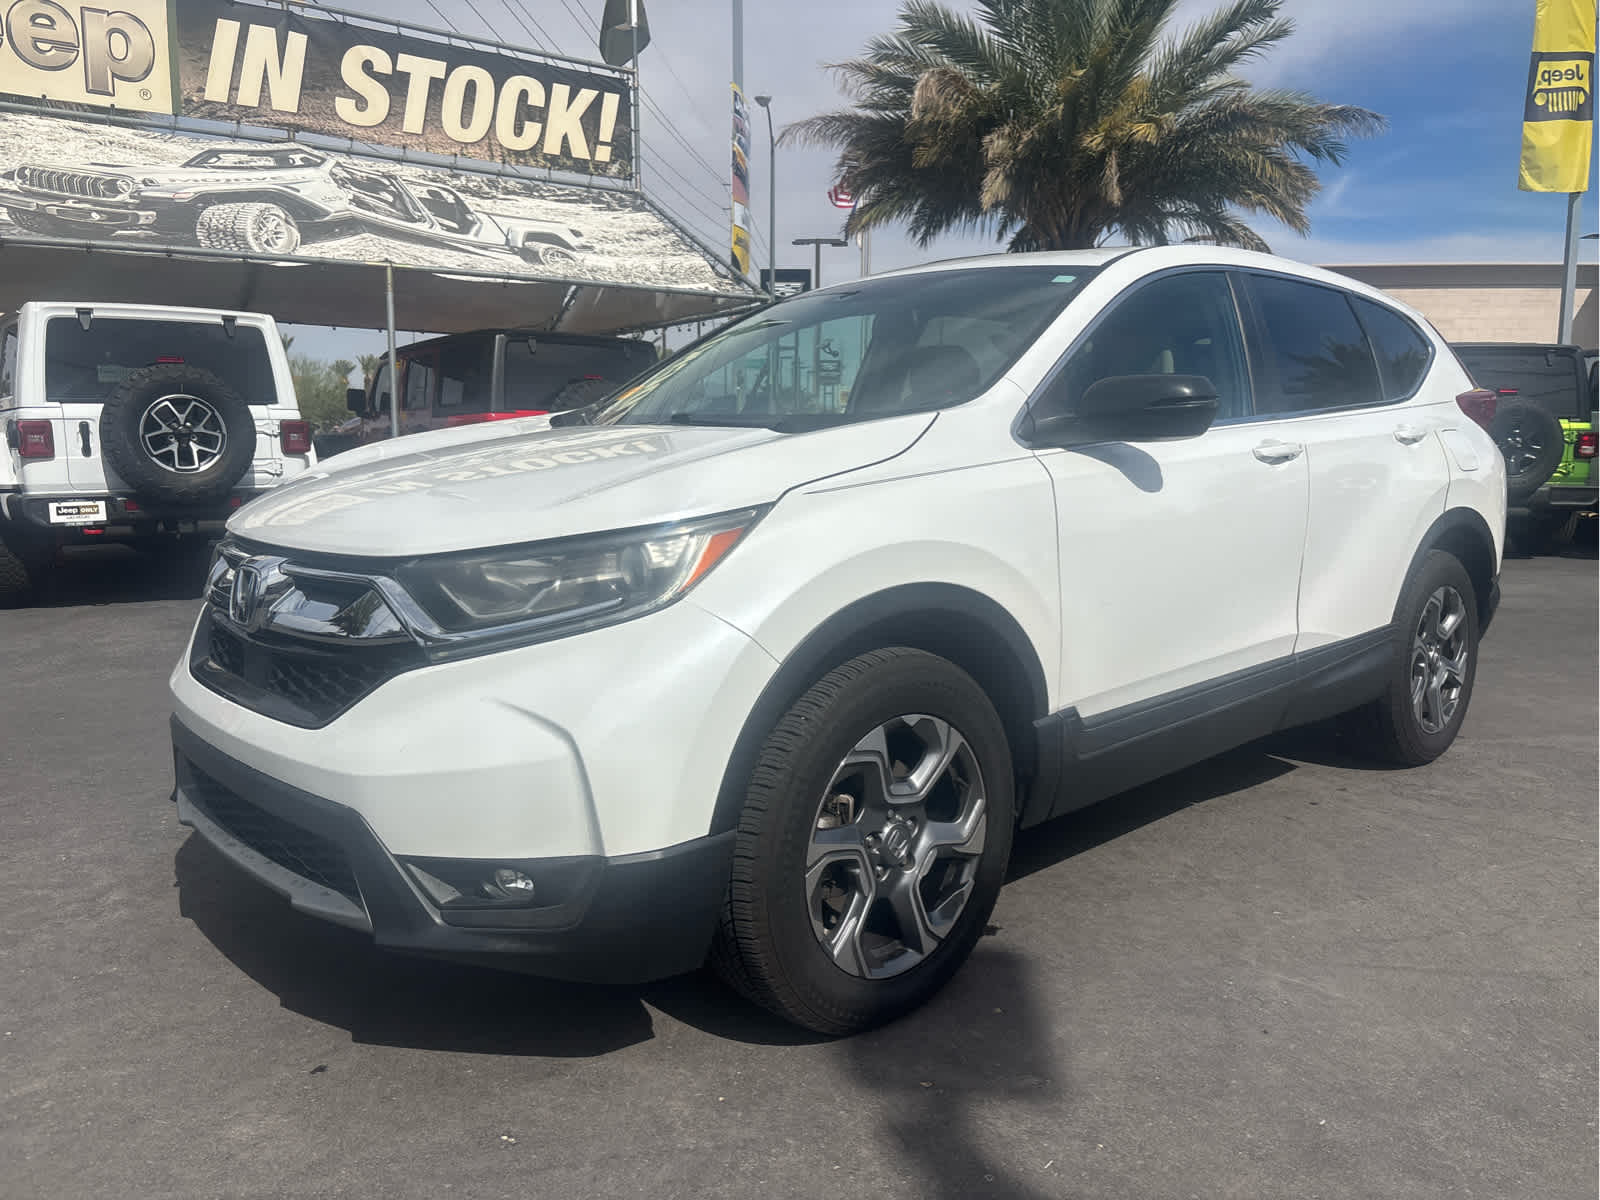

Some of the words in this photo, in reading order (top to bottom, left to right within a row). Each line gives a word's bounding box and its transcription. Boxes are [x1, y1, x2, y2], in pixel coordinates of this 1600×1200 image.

[0, 0, 155, 97] ep
[204, 18, 308, 113] IN
[335, 44, 620, 162] STOCK!
